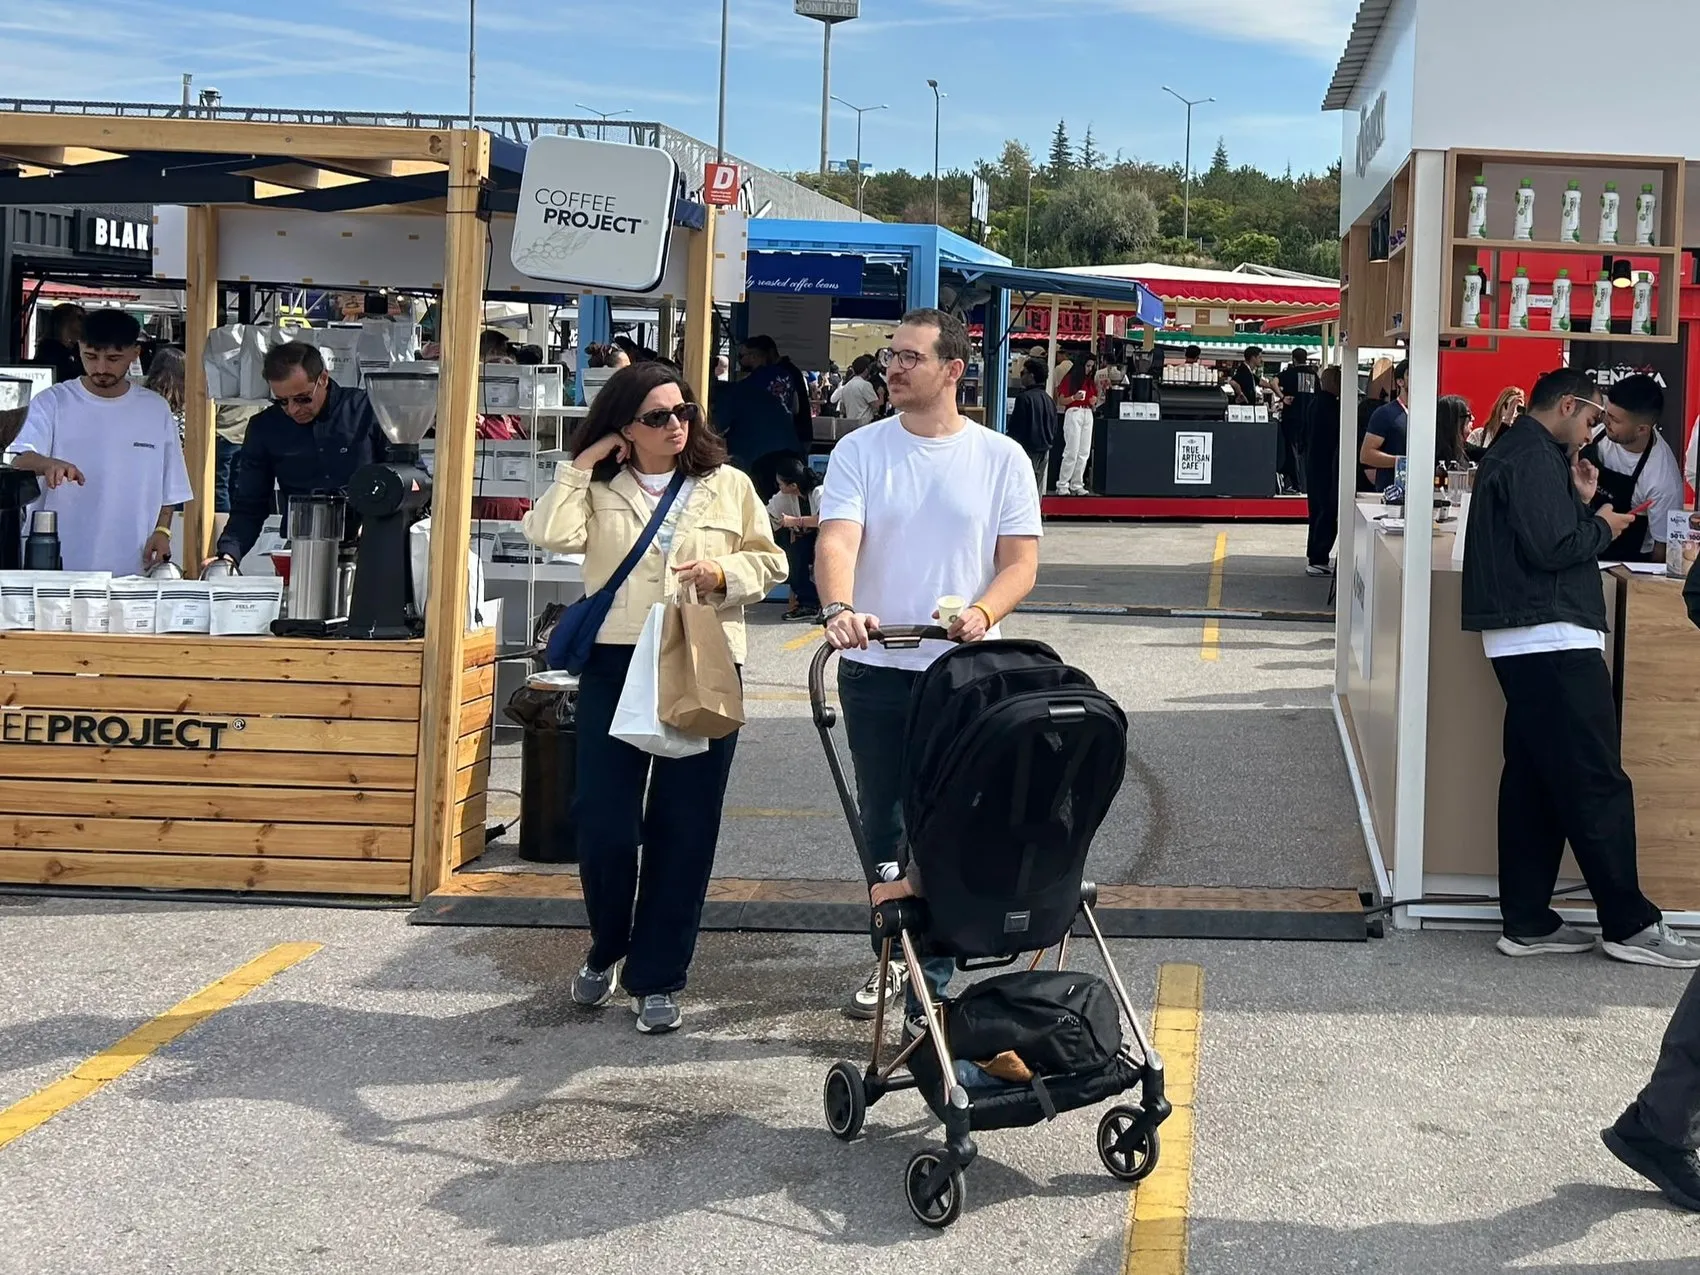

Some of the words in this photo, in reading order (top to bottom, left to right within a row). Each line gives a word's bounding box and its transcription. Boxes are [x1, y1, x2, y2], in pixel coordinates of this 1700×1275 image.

[712, 166, 735, 190] D
[535, 188, 617, 213] COFFEE
[543, 207, 642, 234] PROJECT
[95, 217, 149, 251] BLAK
[758, 277, 791, 287] roasted
[789, 277, 813, 292] coffee
[815, 278, 839, 290] beans
[1182, 446, 1199, 454] TRUE
[1182, 454, 1210, 462] ARTISAN
[1182, 462, 1199, 470] CAFE
